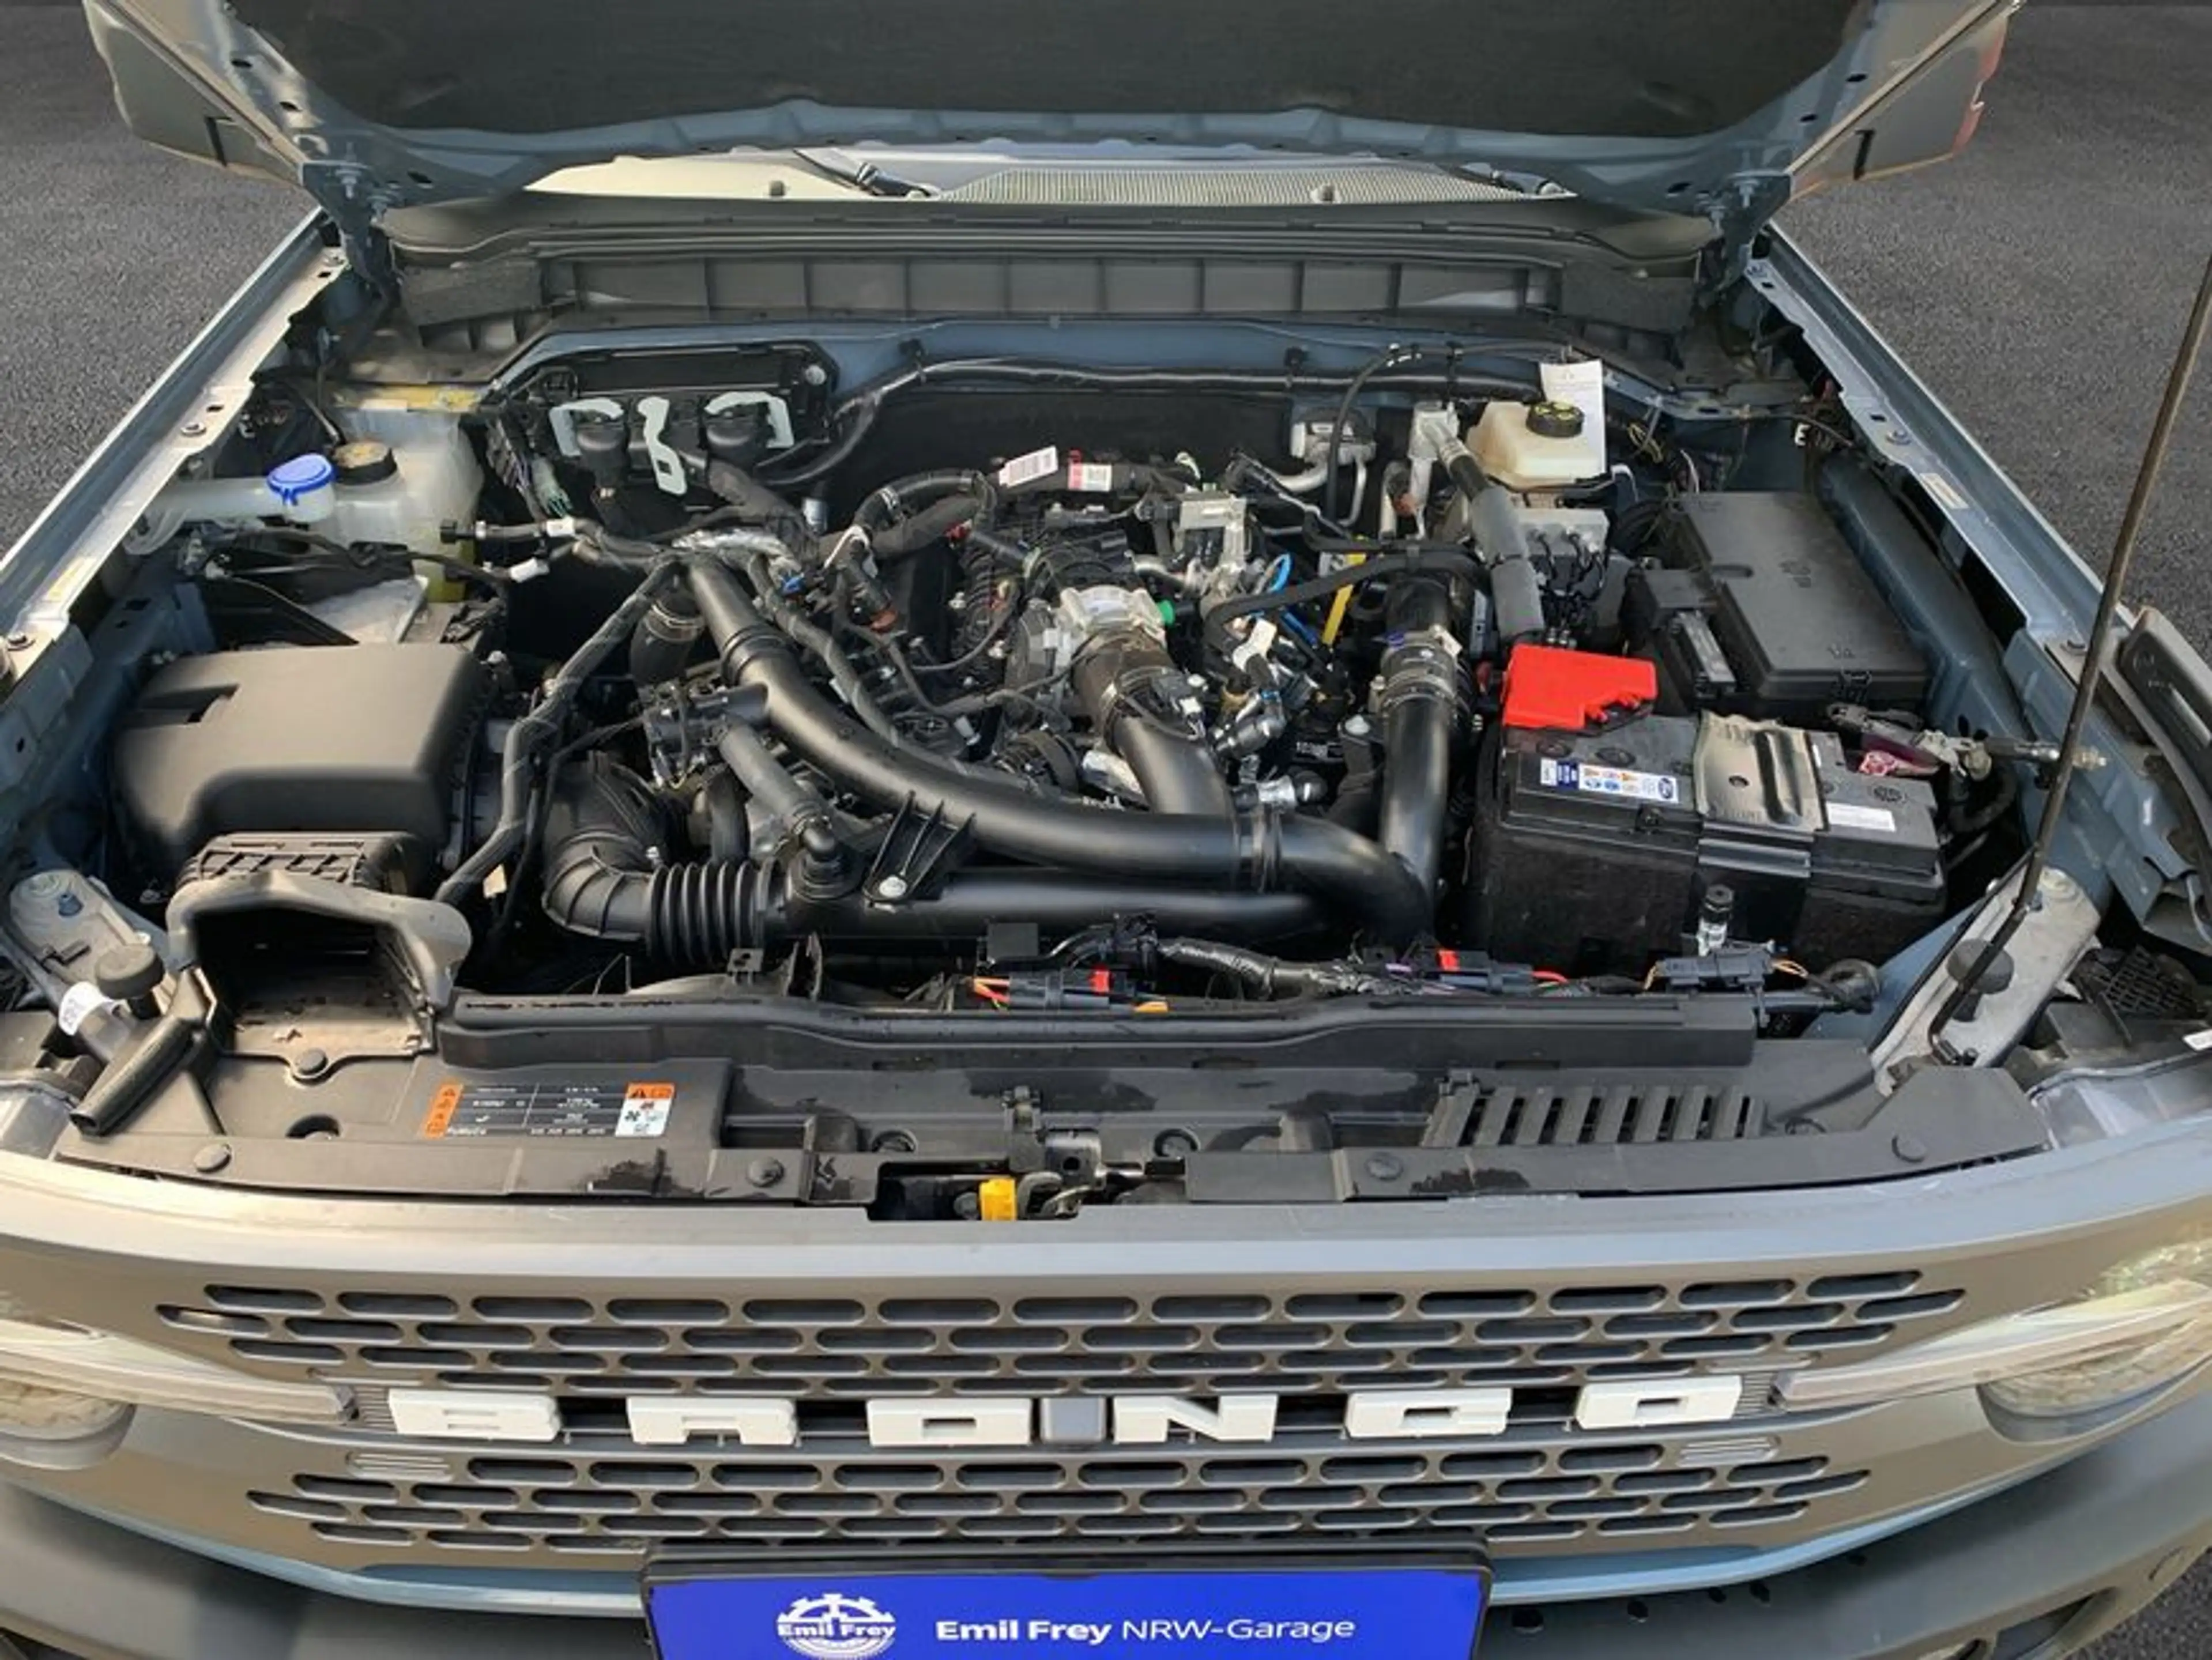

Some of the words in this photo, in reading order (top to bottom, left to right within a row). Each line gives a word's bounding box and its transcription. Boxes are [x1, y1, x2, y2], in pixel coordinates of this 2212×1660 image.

[388, 1374, 1743, 1446] BRONCO
[778, 1622, 834, 1636] Emil
[841, 1622, 896, 1640] Frey
[936, 1619, 1019, 1639] Emil
[1028, 1621, 1111, 1644] Frey
[1122, 1618, 1355, 1642] NRW-Garage
